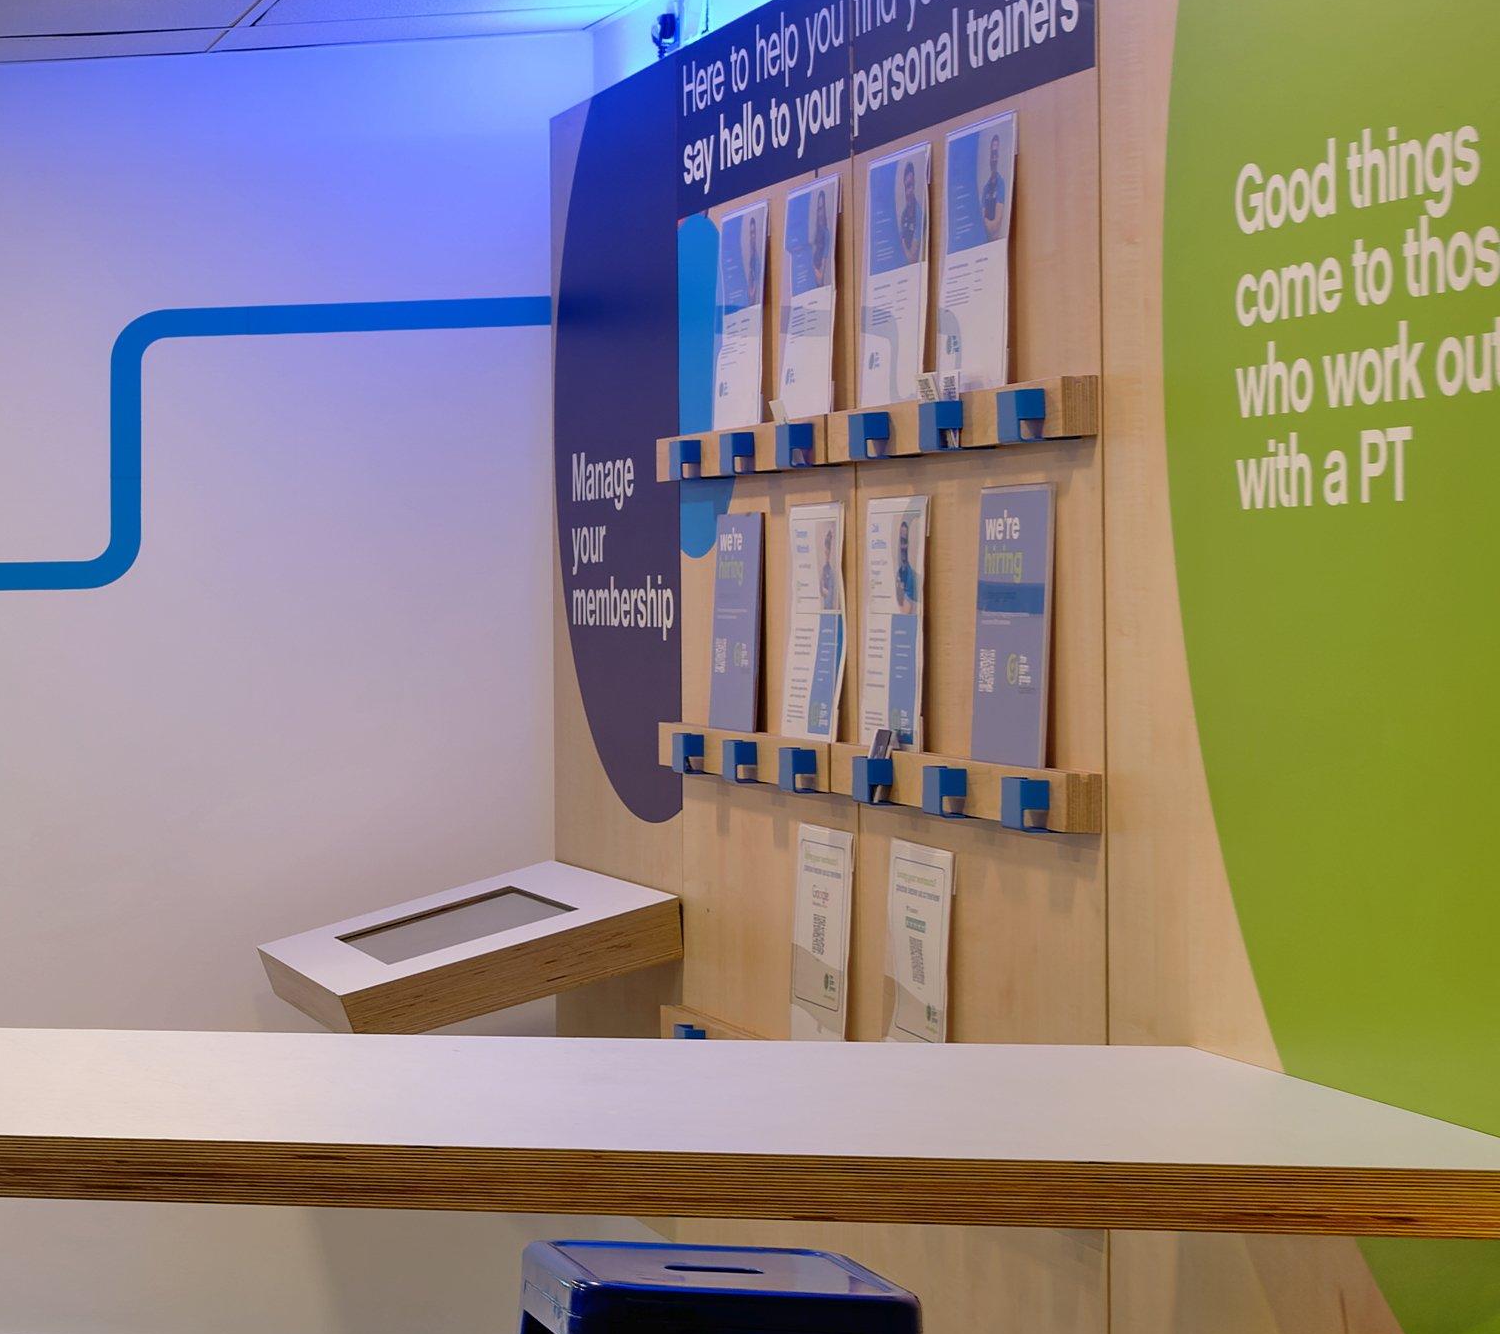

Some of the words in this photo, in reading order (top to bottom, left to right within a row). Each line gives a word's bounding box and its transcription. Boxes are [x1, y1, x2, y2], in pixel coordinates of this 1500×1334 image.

[682, 59, 724, 117] Here
[730, 46, 749, 89] to
[755, 11, 799, 88] help
[805, 4, 845, 75] you
[682, 131, 715, 194] say
[719, 101, 766, 174] hello
[770, 104, 790, 147] to
[796, 80, 845, 158] your
[852, 7, 959, 135] personal
[1234, 137, 1337, 235] Good
[1346, 125, 1481, 219] things
[1235, 256, 1343, 328] come
[1351, 239, 1394, 306] to
[1402, 215, 1500, 298] thos
[1235, 340, 1314, 419] who
[1322, 320, 1426, 408] work
[571, 450, 635, 512] Manage
[1235, 432, 1313, 511] with
[1323, 450, 1348, 506] a
[1359, 426, 1414, 503] PT
[571, 521, 607, 576] your
[719, 527, 744, 553] we're
[985, 509, 1021, 541] we're
[984, 544, 1023, 584] hiring
[571, 574, 675, 641] membership
